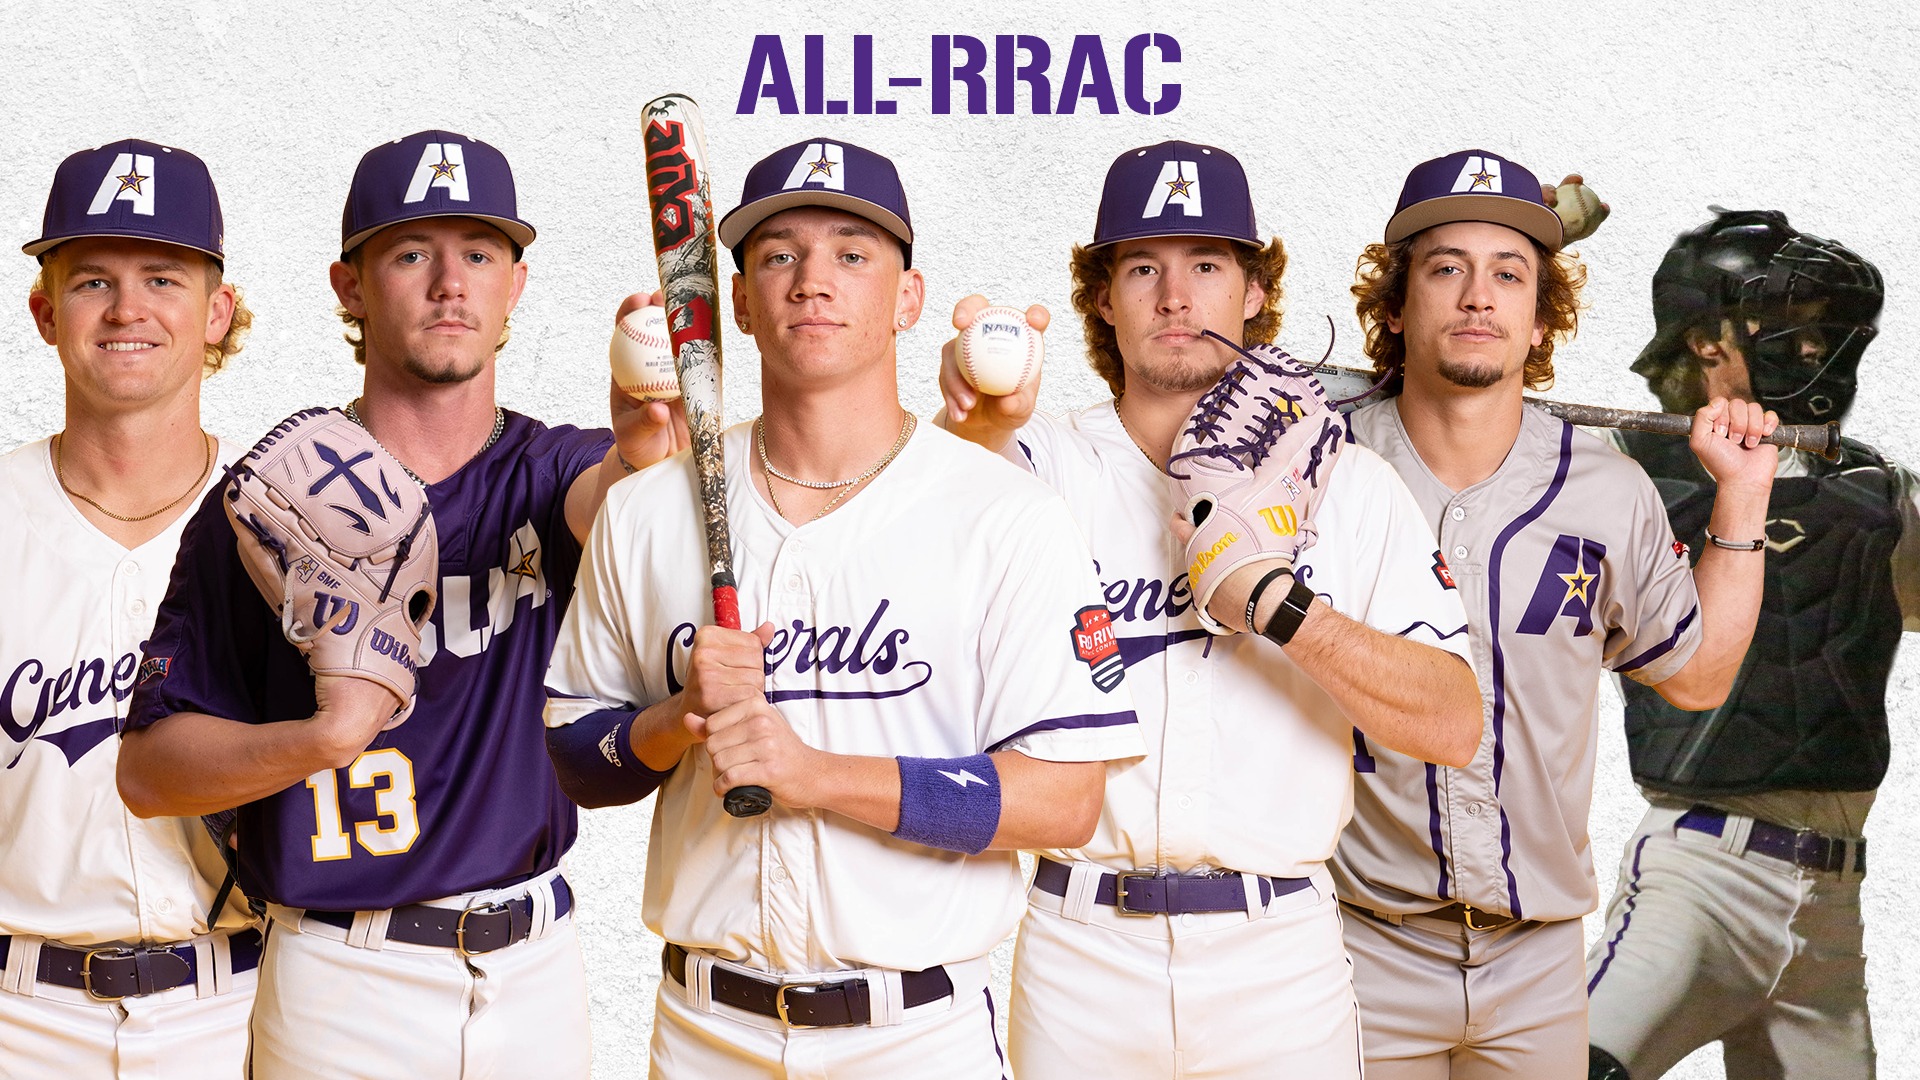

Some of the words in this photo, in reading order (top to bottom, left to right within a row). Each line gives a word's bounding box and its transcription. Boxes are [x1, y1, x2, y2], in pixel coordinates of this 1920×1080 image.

[86, 153, 155, 216] A
[403, 143, 471, 204] A
[781, 143, 845, 192] A
[1142, 160, 1203, 219] A
[1451, 156, 1503, 194] A
[984, 323, 1019, 337] NAIA
[1258, 504, 1298, 538] W
[316, 571, 341, 590] BMF
[1516, 534, 1607, 637] A
[1093, 625, 1116, 647] RIV
[1095, 640, 1117, 653] CONFE
[141, 658, 168, 681] NAIA
[0, 640, 148, 769] Gene
[609, 722, 622, 768] adidas
[305, 747, 421, 862] 13
